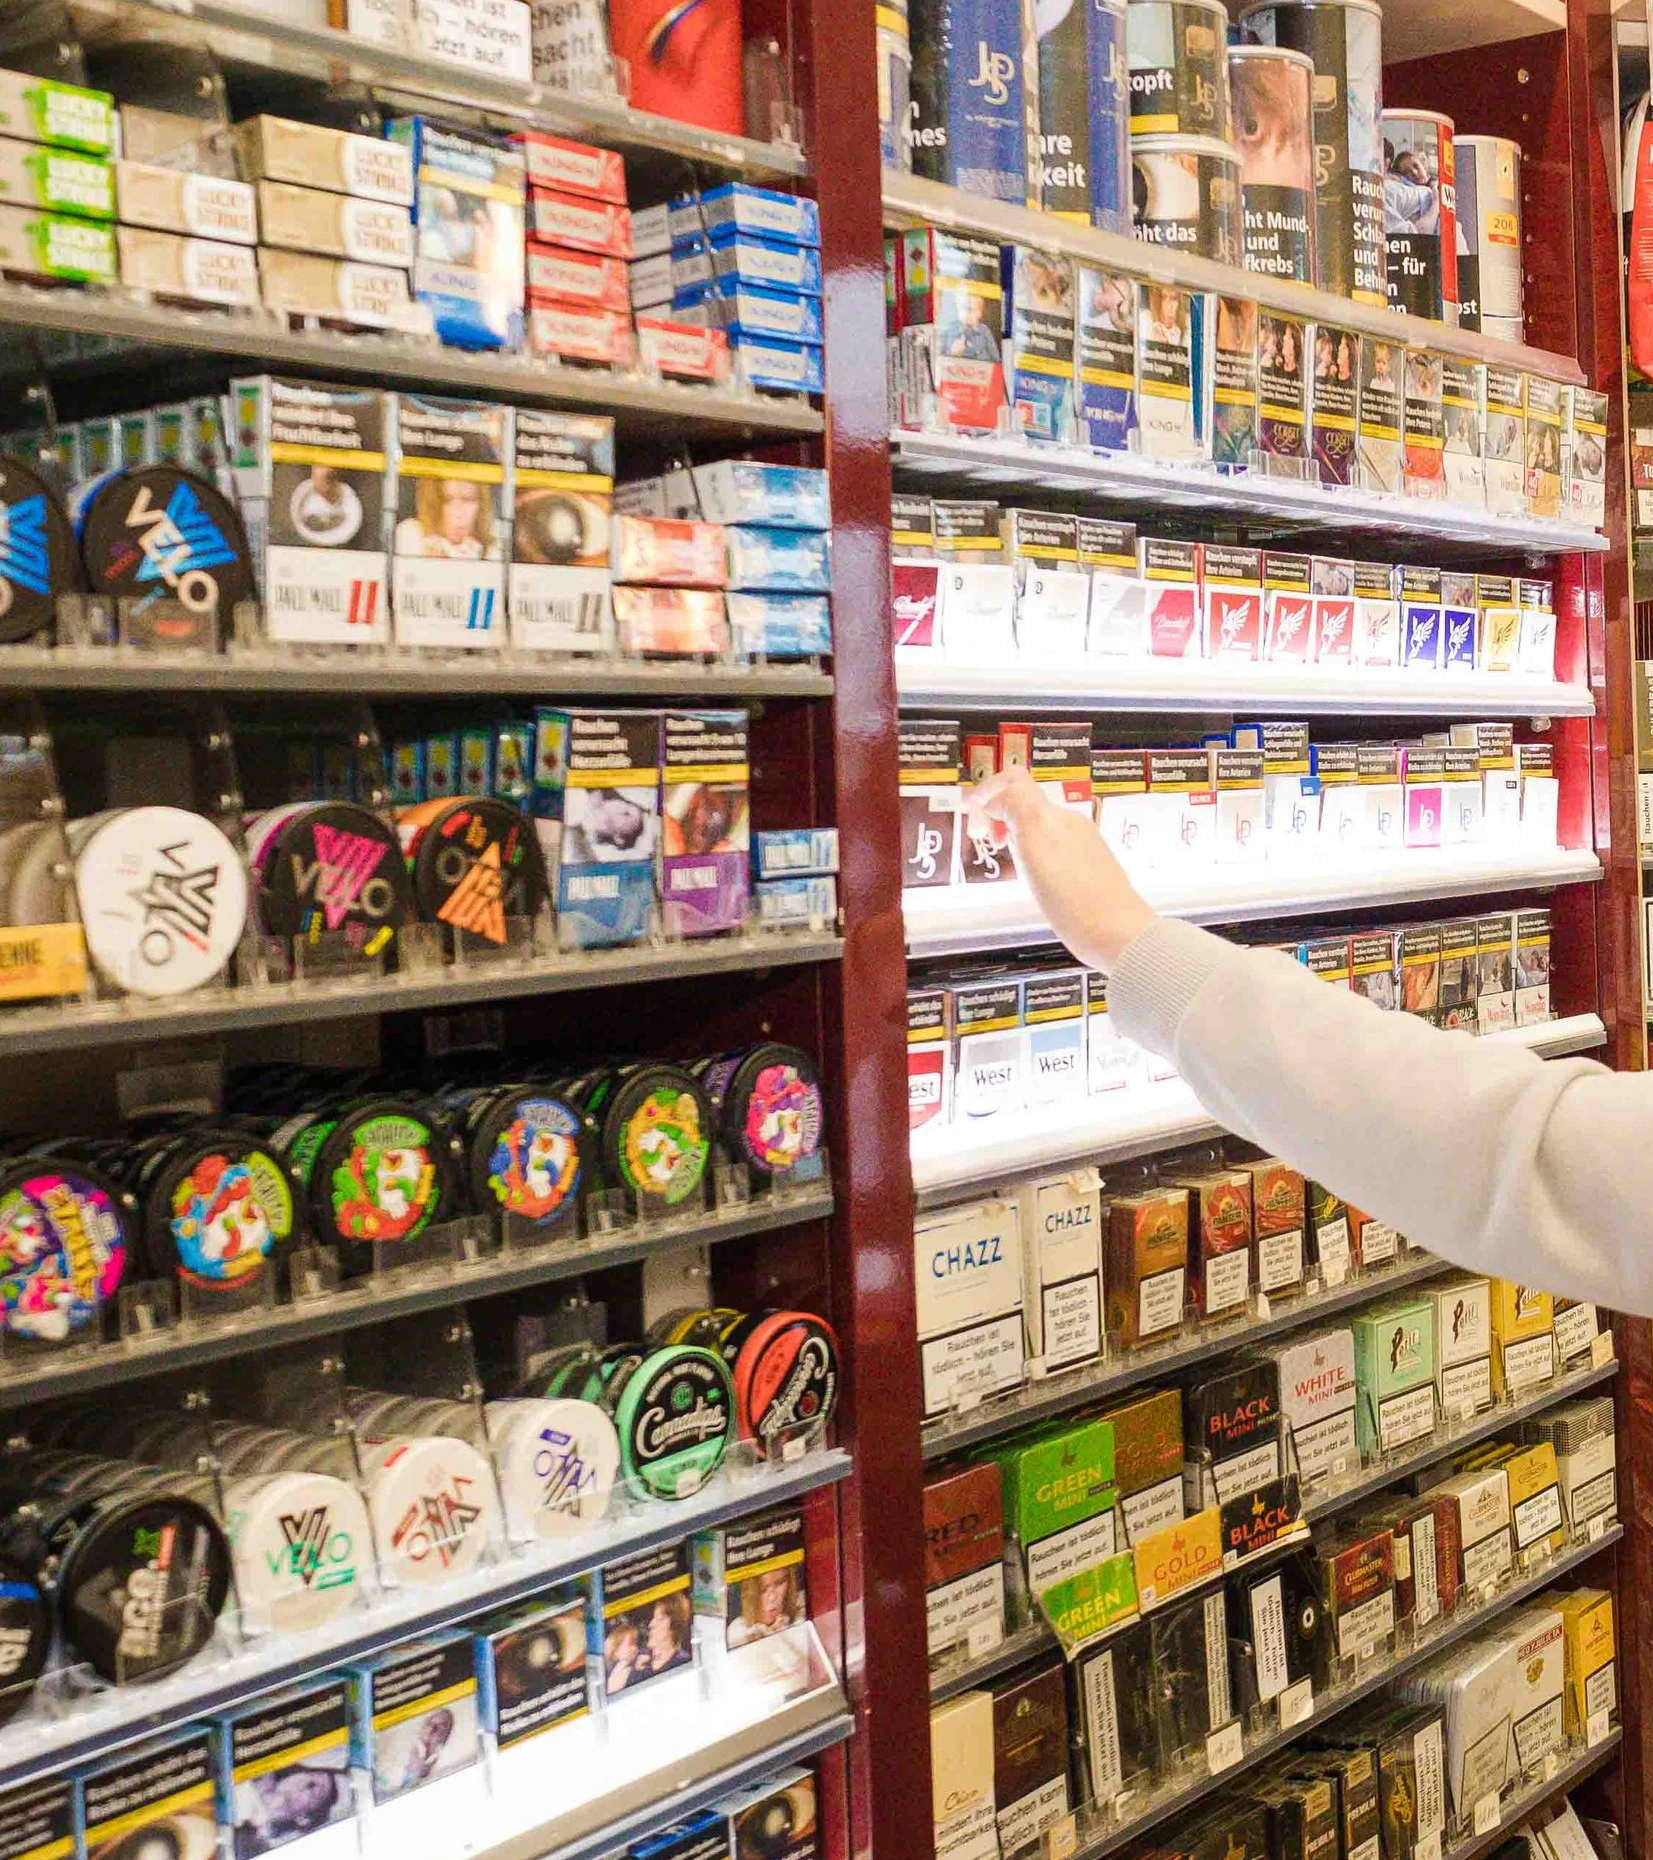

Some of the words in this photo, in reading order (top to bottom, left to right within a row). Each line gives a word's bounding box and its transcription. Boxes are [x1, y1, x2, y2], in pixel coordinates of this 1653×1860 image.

[1247, 233, 1279, 251] und
[1354, 248, 1378, 266] und
[1402, 260, 1426, 276] für
[974, 1066, 1011, 1086] West
[1038, 1054, 1075, 1073] West
[1045, 1205, 1092, 1233] CHAZZ
[932, 1237, 1003, 1279] CHAZZ
[1294, 1366, 1346, 1398] WHITE
[1209, 1396, 1271, 1436] BLACK
[1036, 1467, 1101, 1504] GREEN
[1053, 1492, 1082, 1513] MINI
[1229, 1505, 1290, 1546] BLACK
[1030, 1542, 1065, 1564] Rauchen
[1079, 1524, 1107, 1544] tödlich
[1246, 1530, 1275, 1551] MINI
[1060, 1559, 1073, 1573] Sie
[1154, 1545, 1207, 1582] GOLD
[1058, 1589, 1120, 1631] GREEN
